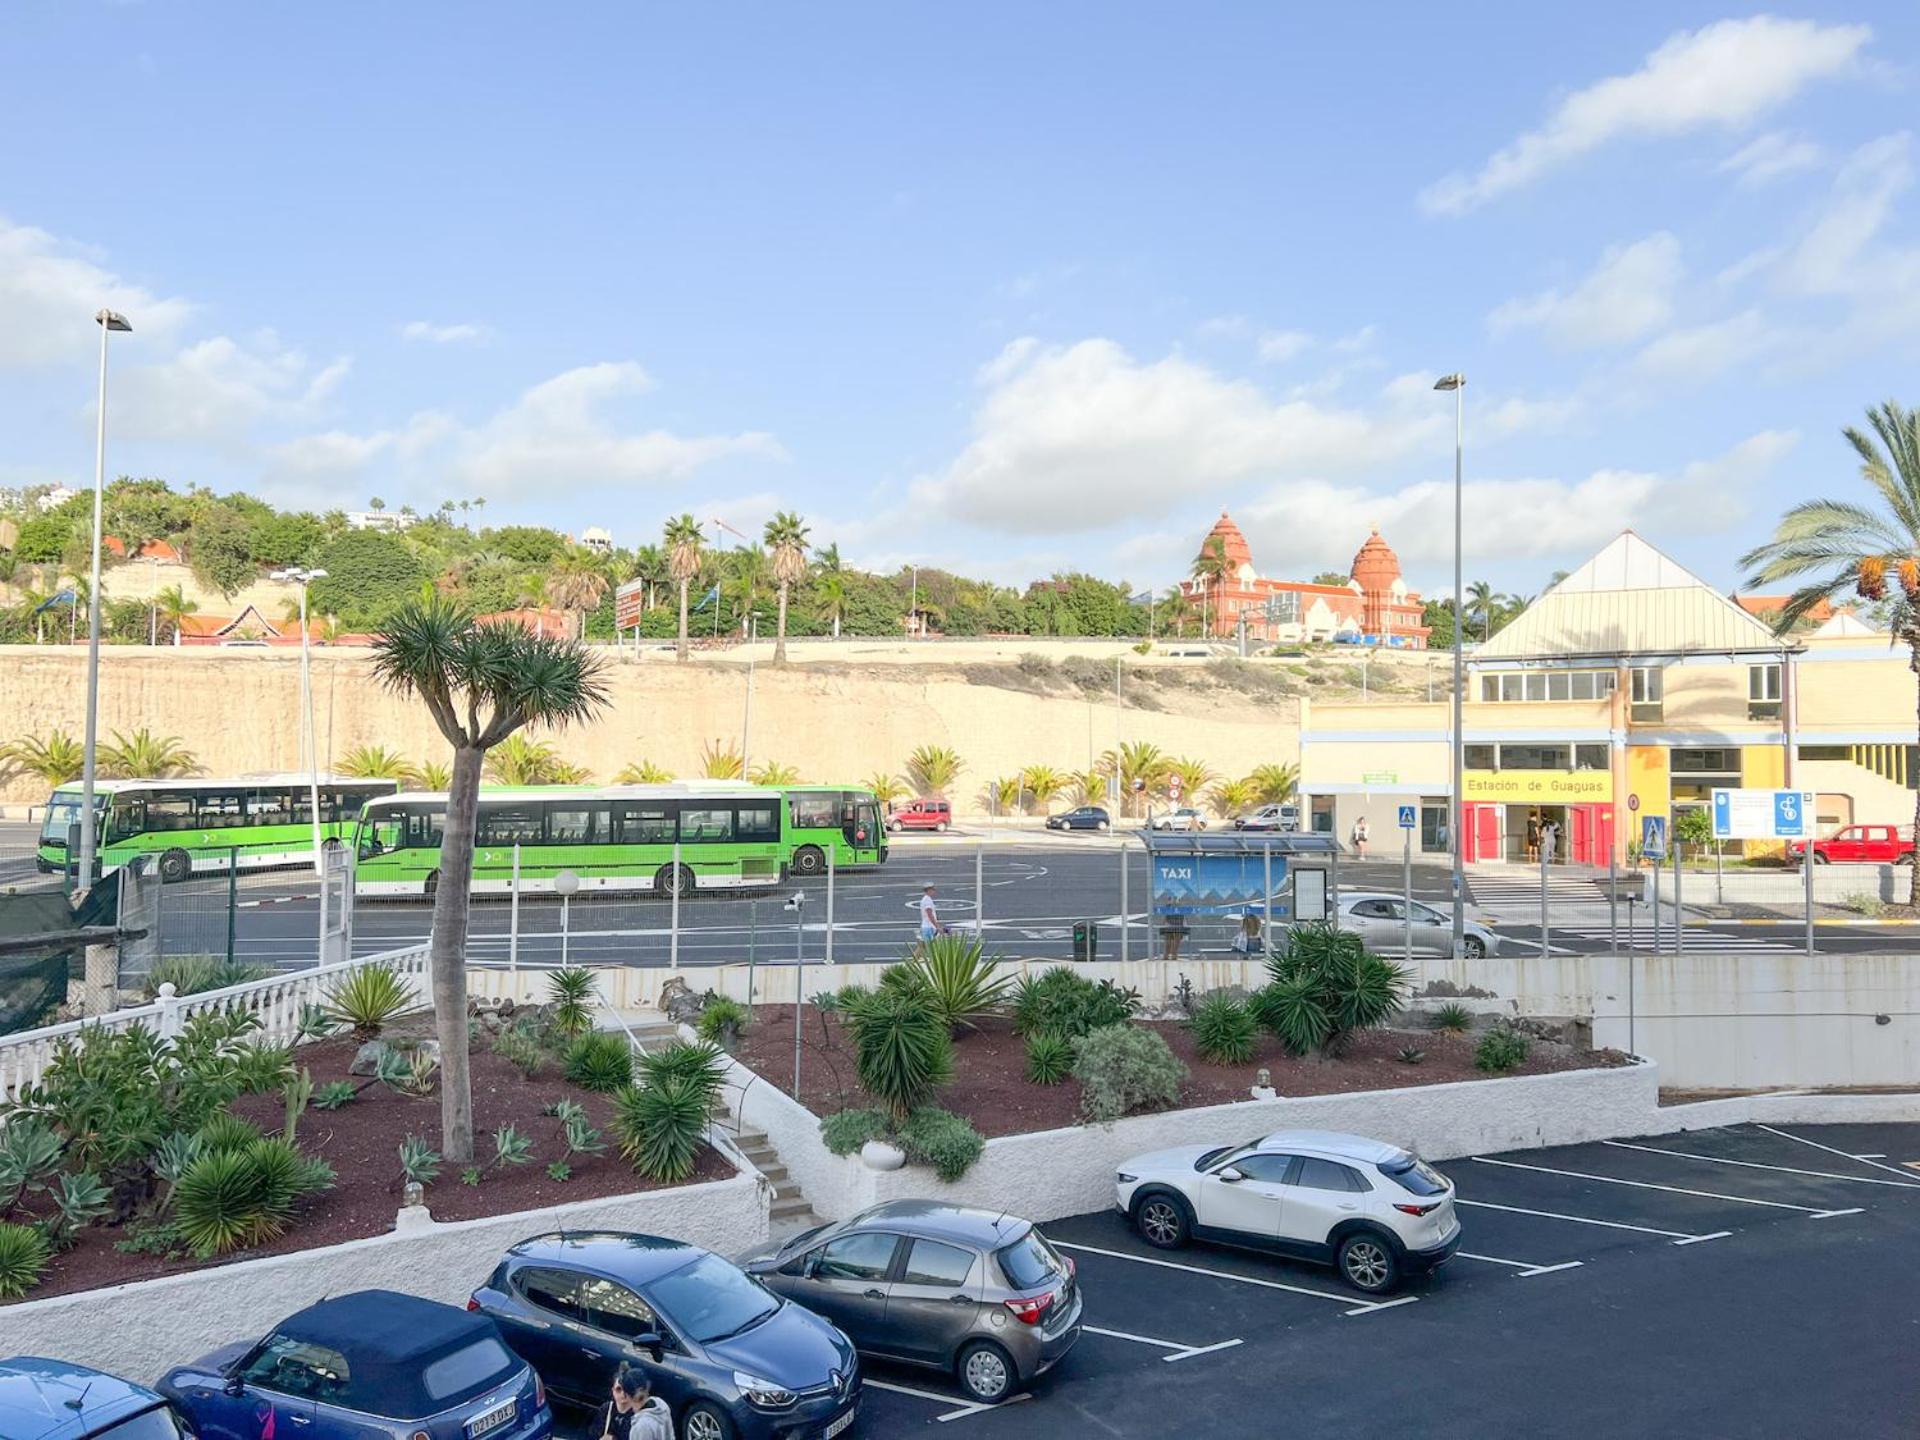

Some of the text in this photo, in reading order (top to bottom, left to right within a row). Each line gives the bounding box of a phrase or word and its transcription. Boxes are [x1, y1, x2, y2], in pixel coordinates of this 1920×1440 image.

[1528, 780, 1542, 791] de
[1551, 780, 1603, 794] Guaguas
[1161, 868, 1191, 879] TAXI
